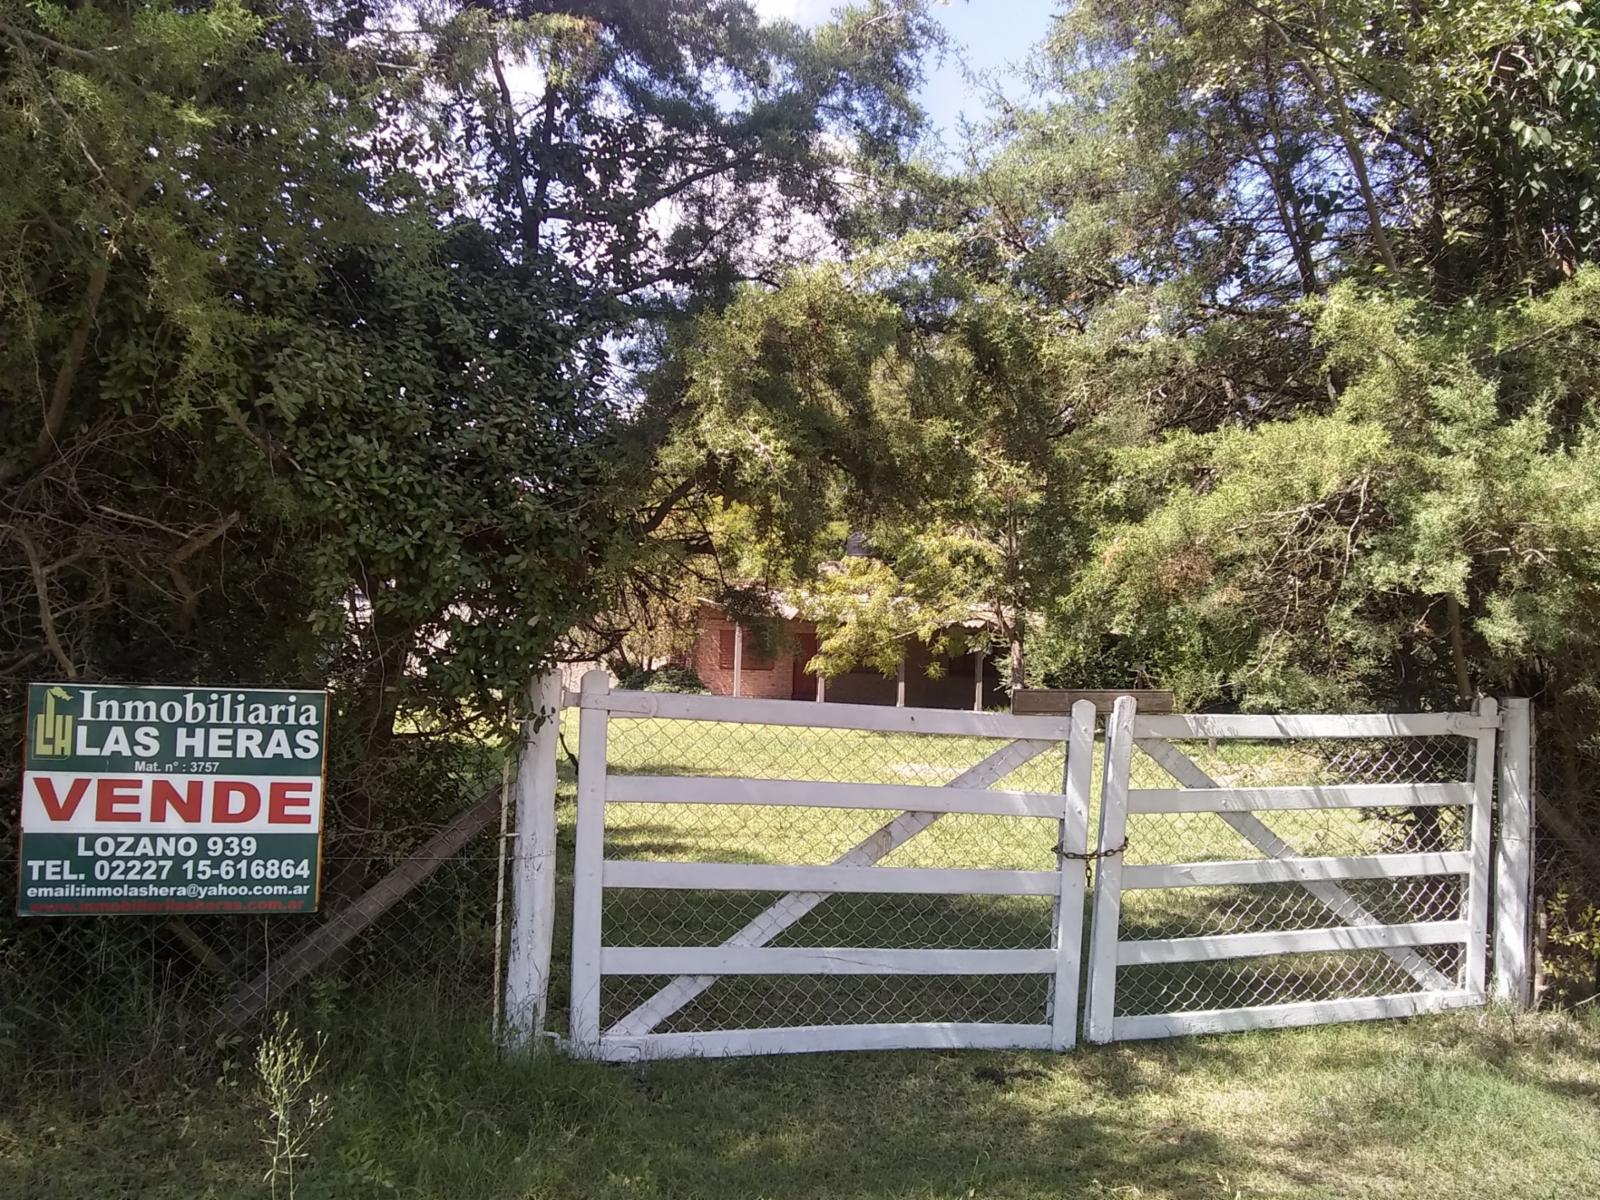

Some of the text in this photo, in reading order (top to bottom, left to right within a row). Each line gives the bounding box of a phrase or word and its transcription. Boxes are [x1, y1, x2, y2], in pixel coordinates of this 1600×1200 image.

[78, 690, 319, 726] Inmobiliaria
[76, 726, 319, 760] LAS HERAS
[134, 761, 161, 773] Mat.
[190, 762, 220, 773] 3757
[33, 777, 313, 825] VENDE
[77, 836, 257, 857] LOZANO 939
[27, 859, 310, 880] TEL. 02227 15-616864
[26, 883, 310, 899] email:inmolashera@yahoo.com.ar
